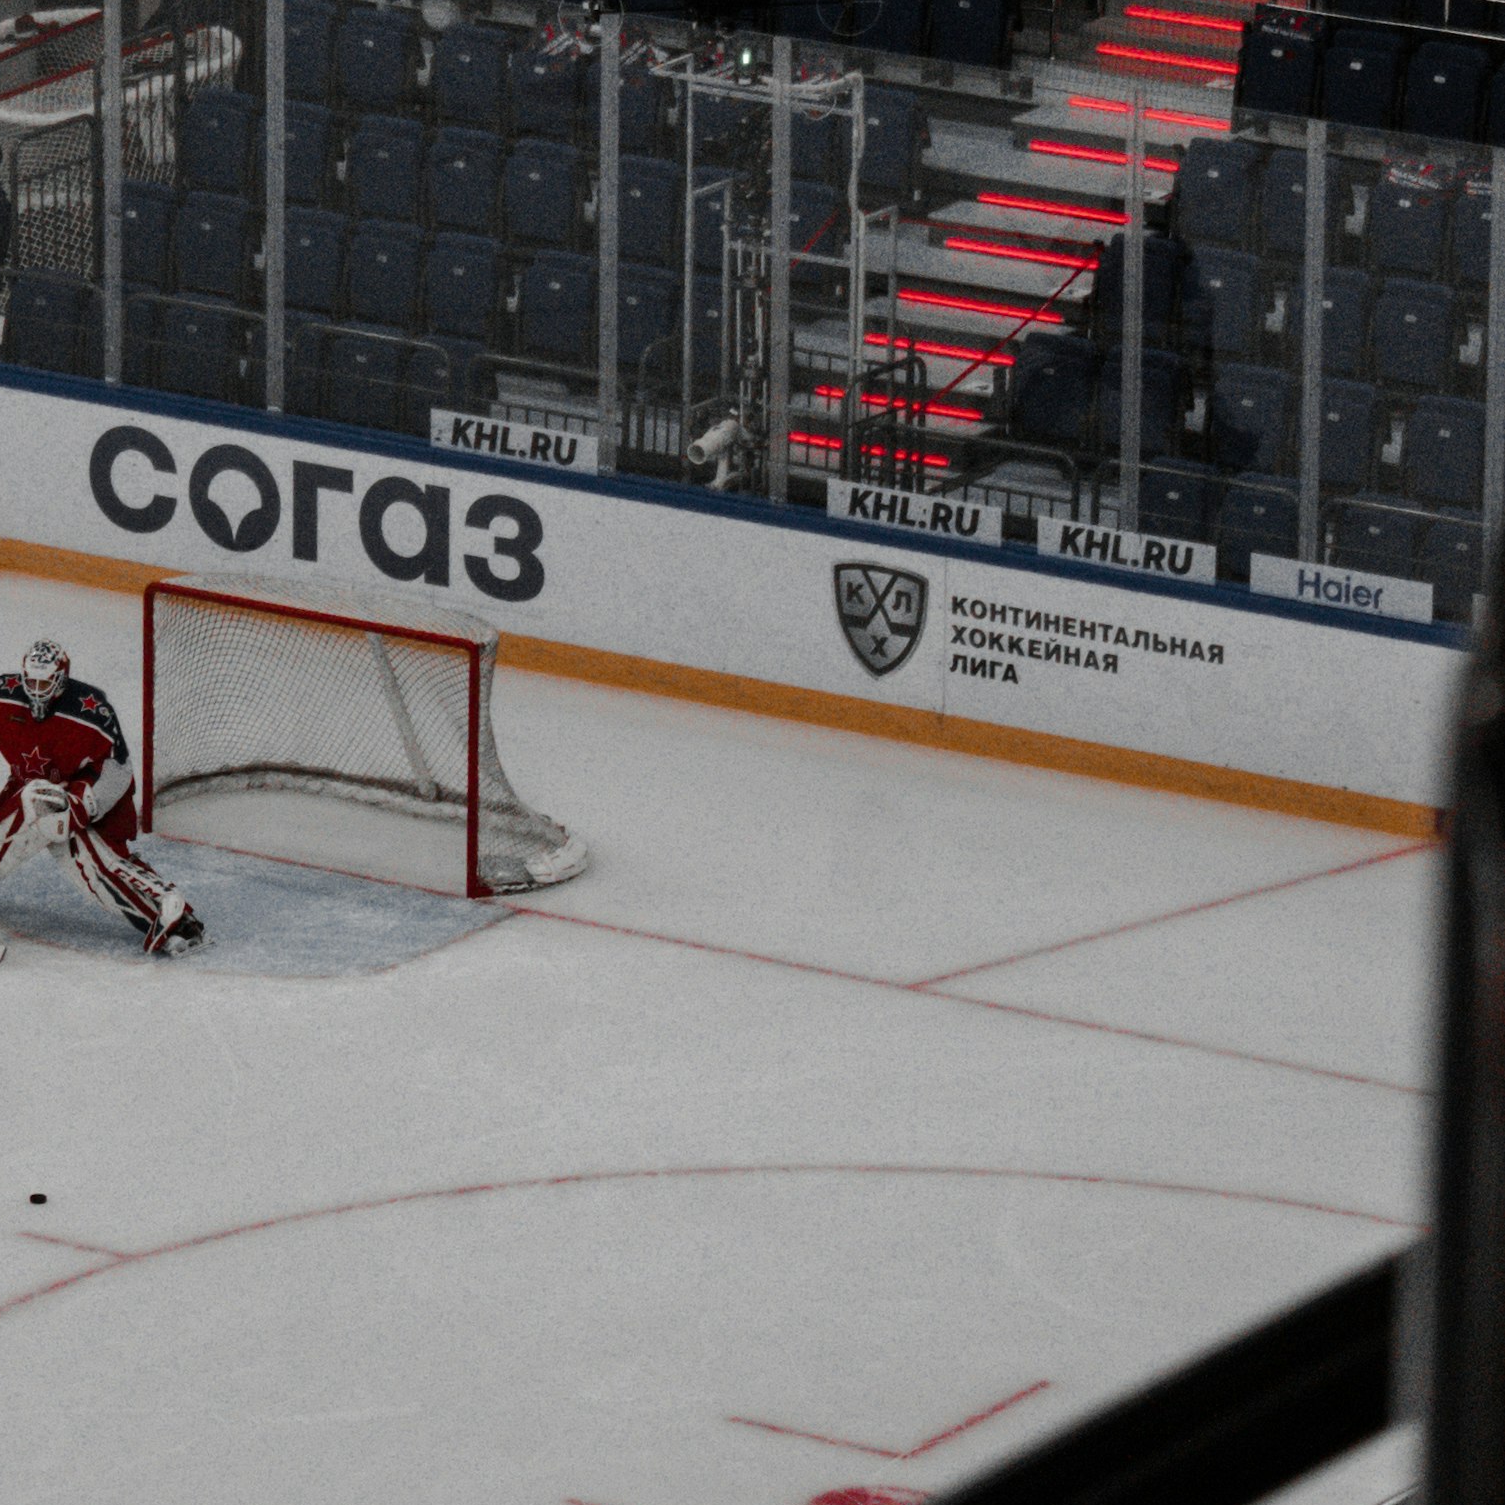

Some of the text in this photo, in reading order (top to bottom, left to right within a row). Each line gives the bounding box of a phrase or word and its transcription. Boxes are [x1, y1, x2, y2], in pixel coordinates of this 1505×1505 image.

[451, 416, 578, 467] KHL.RU
[847, 487, 980, 538] KHL.RU
[1058, 525, 1194, 577] KHL.RU
[1298, 569, 1383, 612] Haier
[950, 624, 1119, 674] ХОККЕЙНАЯ
[951, 595, 1225, 666] КОНТИНЕНТАЛЬНАЯ
[949, 654, 1019, 685] ЛИГА
